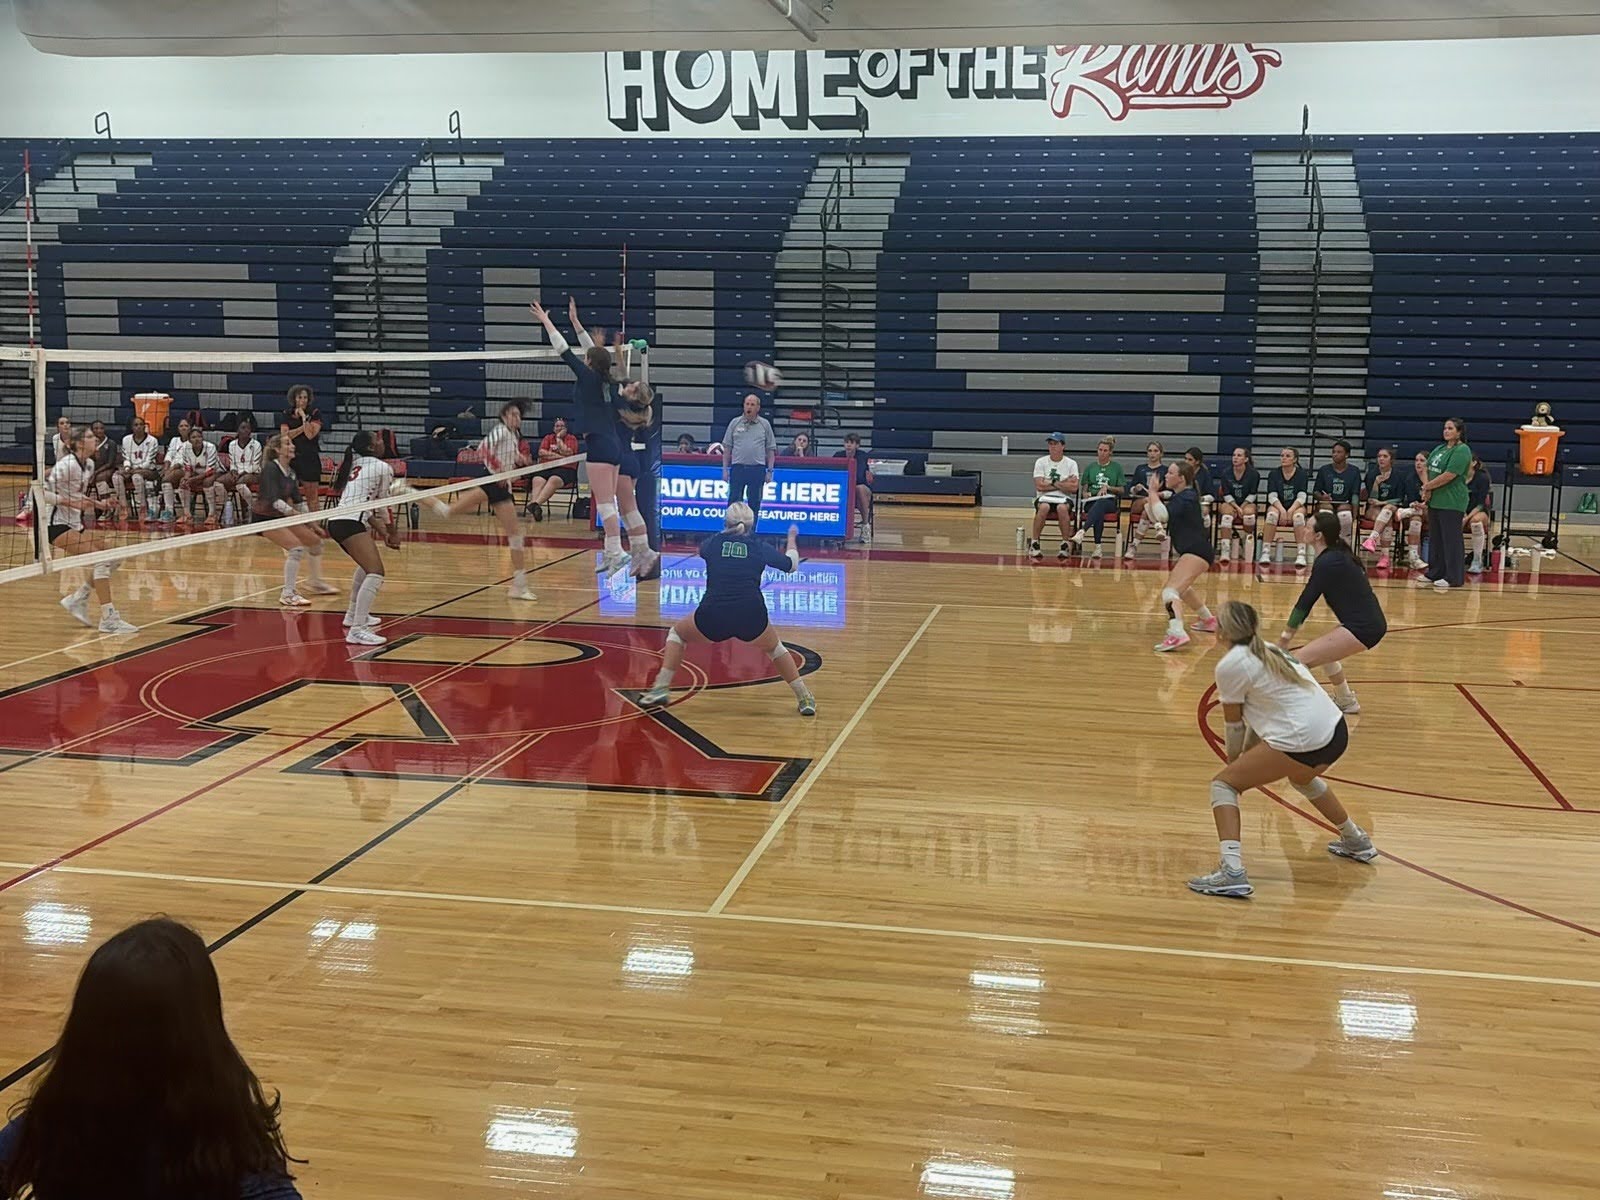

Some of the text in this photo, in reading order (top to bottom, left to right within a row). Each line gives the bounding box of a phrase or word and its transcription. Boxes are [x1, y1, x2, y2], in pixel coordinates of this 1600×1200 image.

[605, 43, 1283, 132] HOME OF THE Rams
[348, 465, 362, 482] 3
[661, 478, 841, 503] ADVERE HERE
[661, 507, 683, 516] OUR
[685, 507, 701, 517] AD
[702, 508, 726, 518] COU
[809, 511, 840, 522] HERE!
[721, 541, 748, 559] 10
